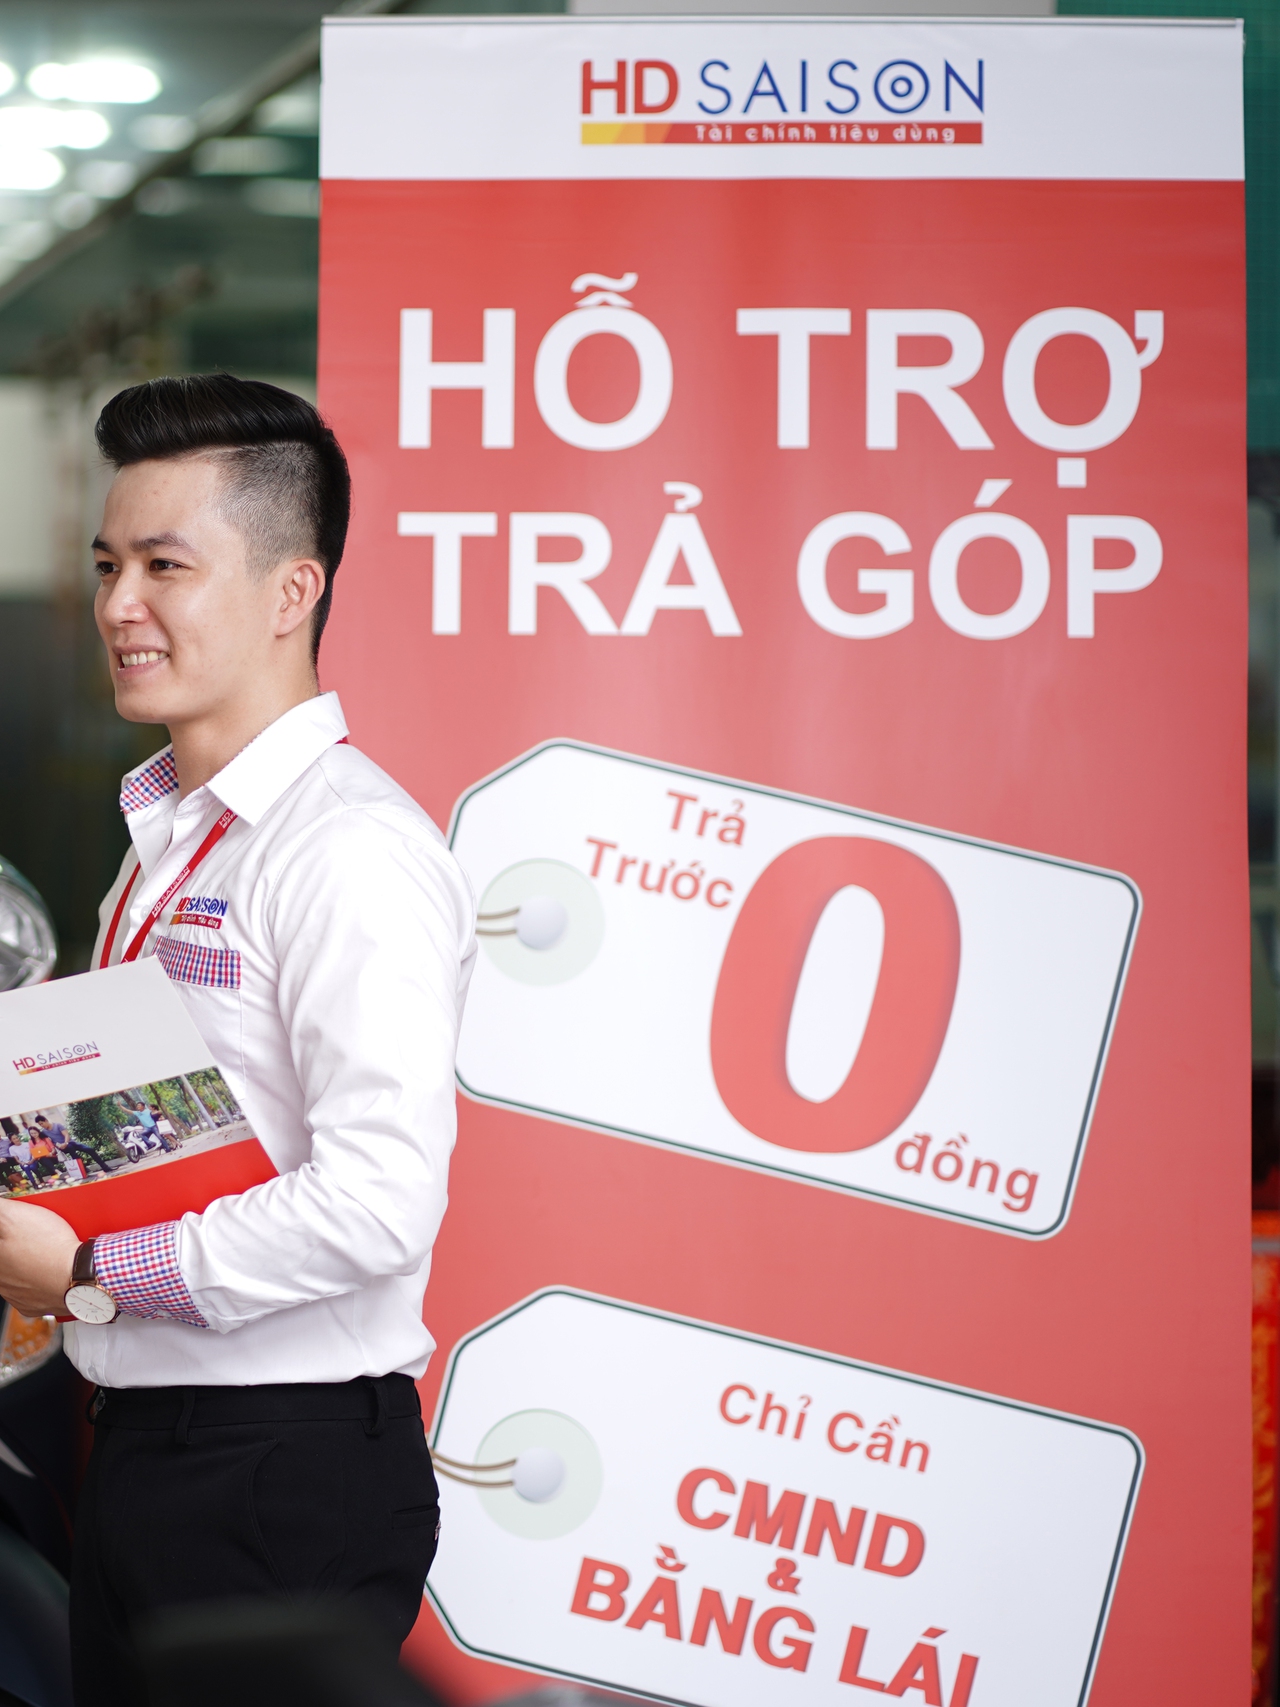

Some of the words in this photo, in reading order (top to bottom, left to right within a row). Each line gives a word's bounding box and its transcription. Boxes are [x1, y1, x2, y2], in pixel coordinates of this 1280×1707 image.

[581, 59, 680, 115] HD
[697, 59, 985, 115] SAISON
[745, 122, 817, 142] chính
[398, 271, 674, 452] HỖ
[736, 307, 1165, 489] TRỢ
[397, 479, 743, 637] TRẢ
[796, 478, 1164, 641] GÓP
[666, 789, 746, 846] Trả
[186, 896, 228, 917] SAISON
[586, 836, 734, 909] Trước
[709, 834, 963, 1155] 0
[12, 1056, 36, 1071] HD
[37, 1041, 99, 1065] SAISON
[894, 1132, 1040, 1213] đồng
[718, 1383, 813, 1441] Chỉ
[826, 1414, 932, 1474] Cần
[675, 1466, 926, 1578] CMND
[766, 1557, 800, 1594] &
[569, 1543, 816, 1674] BẰNG
[836, 1624, 980, 1707] LÁI
